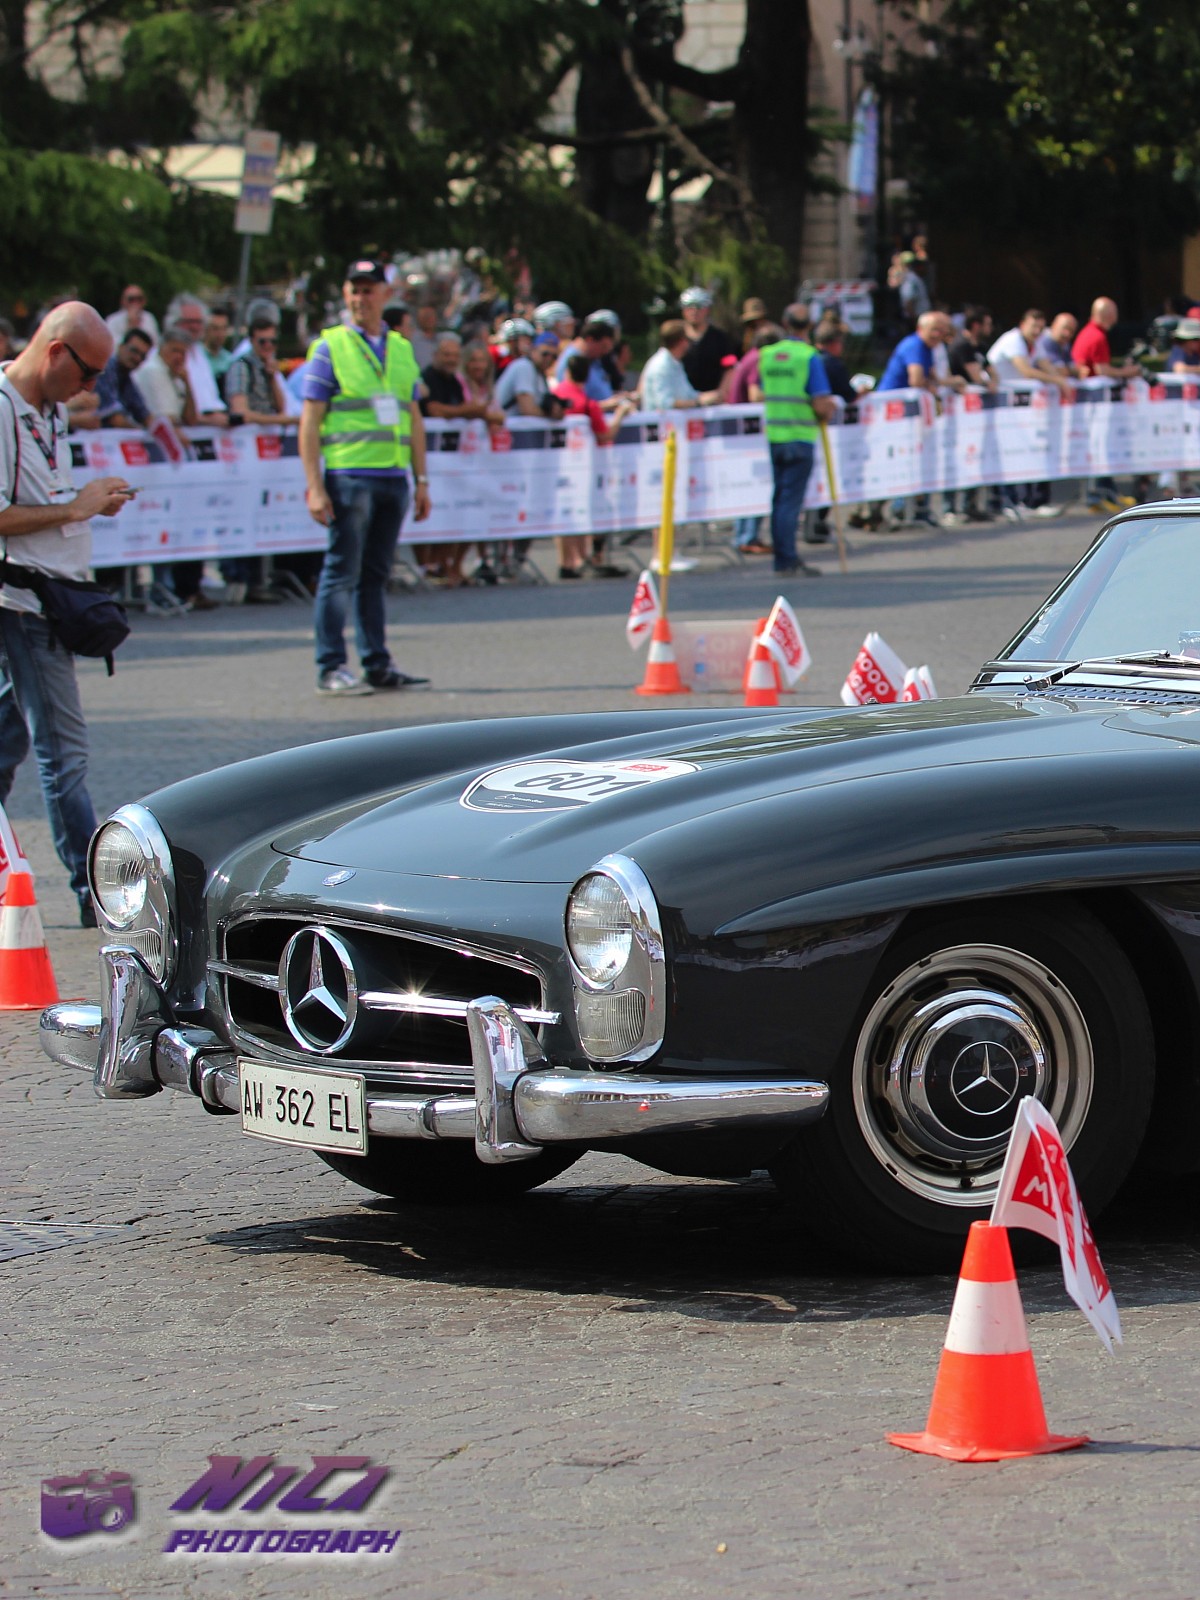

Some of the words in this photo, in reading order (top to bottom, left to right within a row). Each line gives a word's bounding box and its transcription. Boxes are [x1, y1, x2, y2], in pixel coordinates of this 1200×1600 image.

[514, 772, 651, 796] 601
[275, 1085, 315, 1127] 362
[328, 1093, 359, 1134] EL
